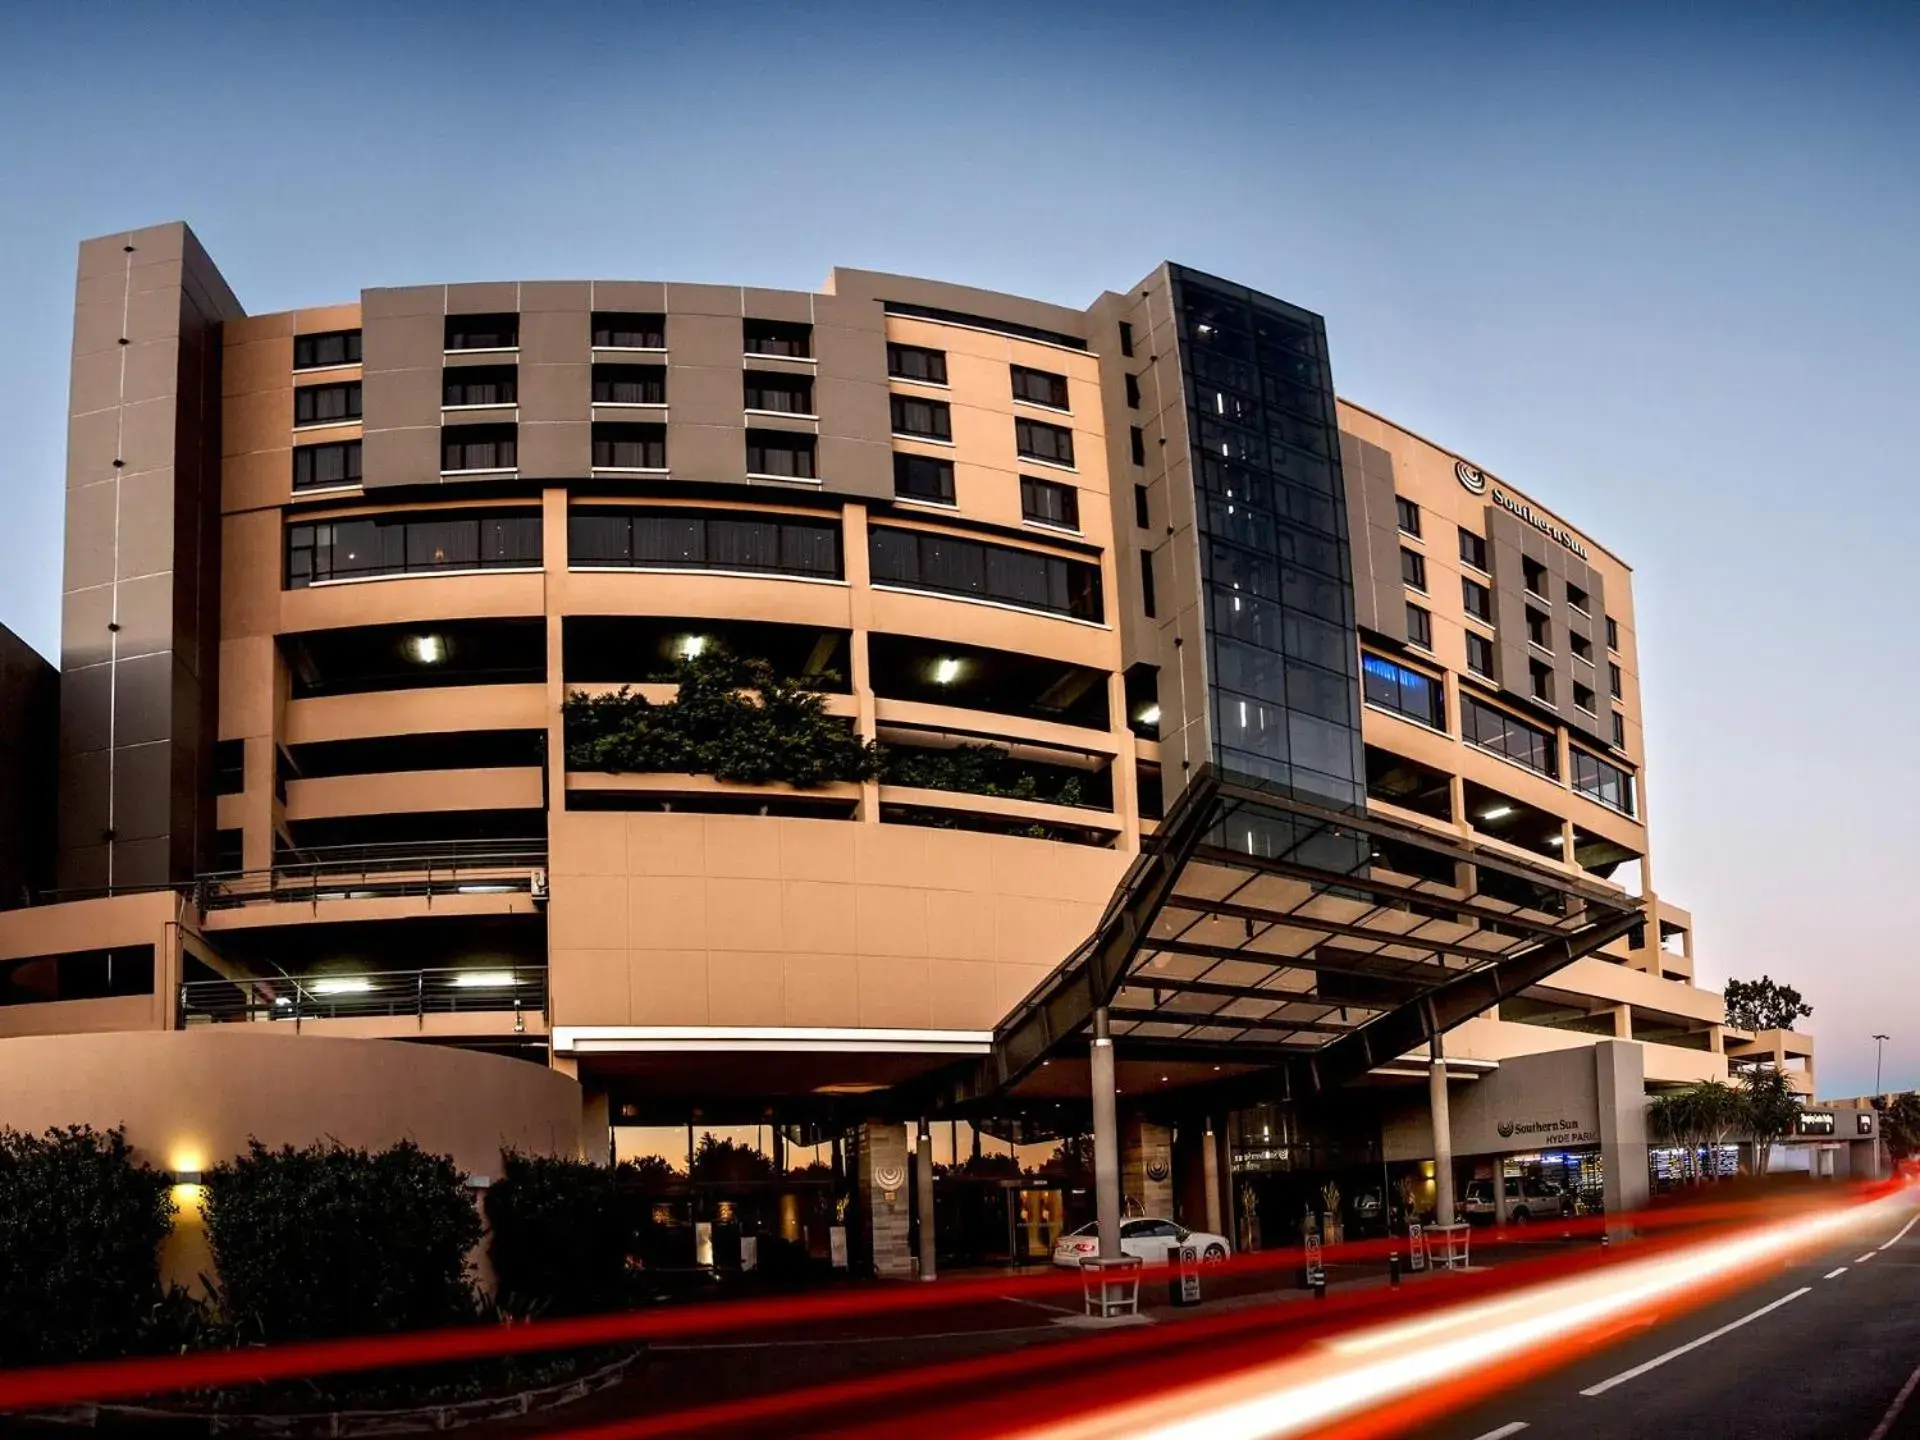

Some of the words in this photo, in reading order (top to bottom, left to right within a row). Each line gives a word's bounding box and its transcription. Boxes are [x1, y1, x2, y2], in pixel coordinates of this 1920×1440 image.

[1492, 488, 1561, 543] Southern
[1562, 531, 1587, 560] Sun
[1515, 1121, 1558, 1135] Southern
[1559, 1119, 1578, 1130] Sun
[1546, 1133, 1570, 1144] HYDE
